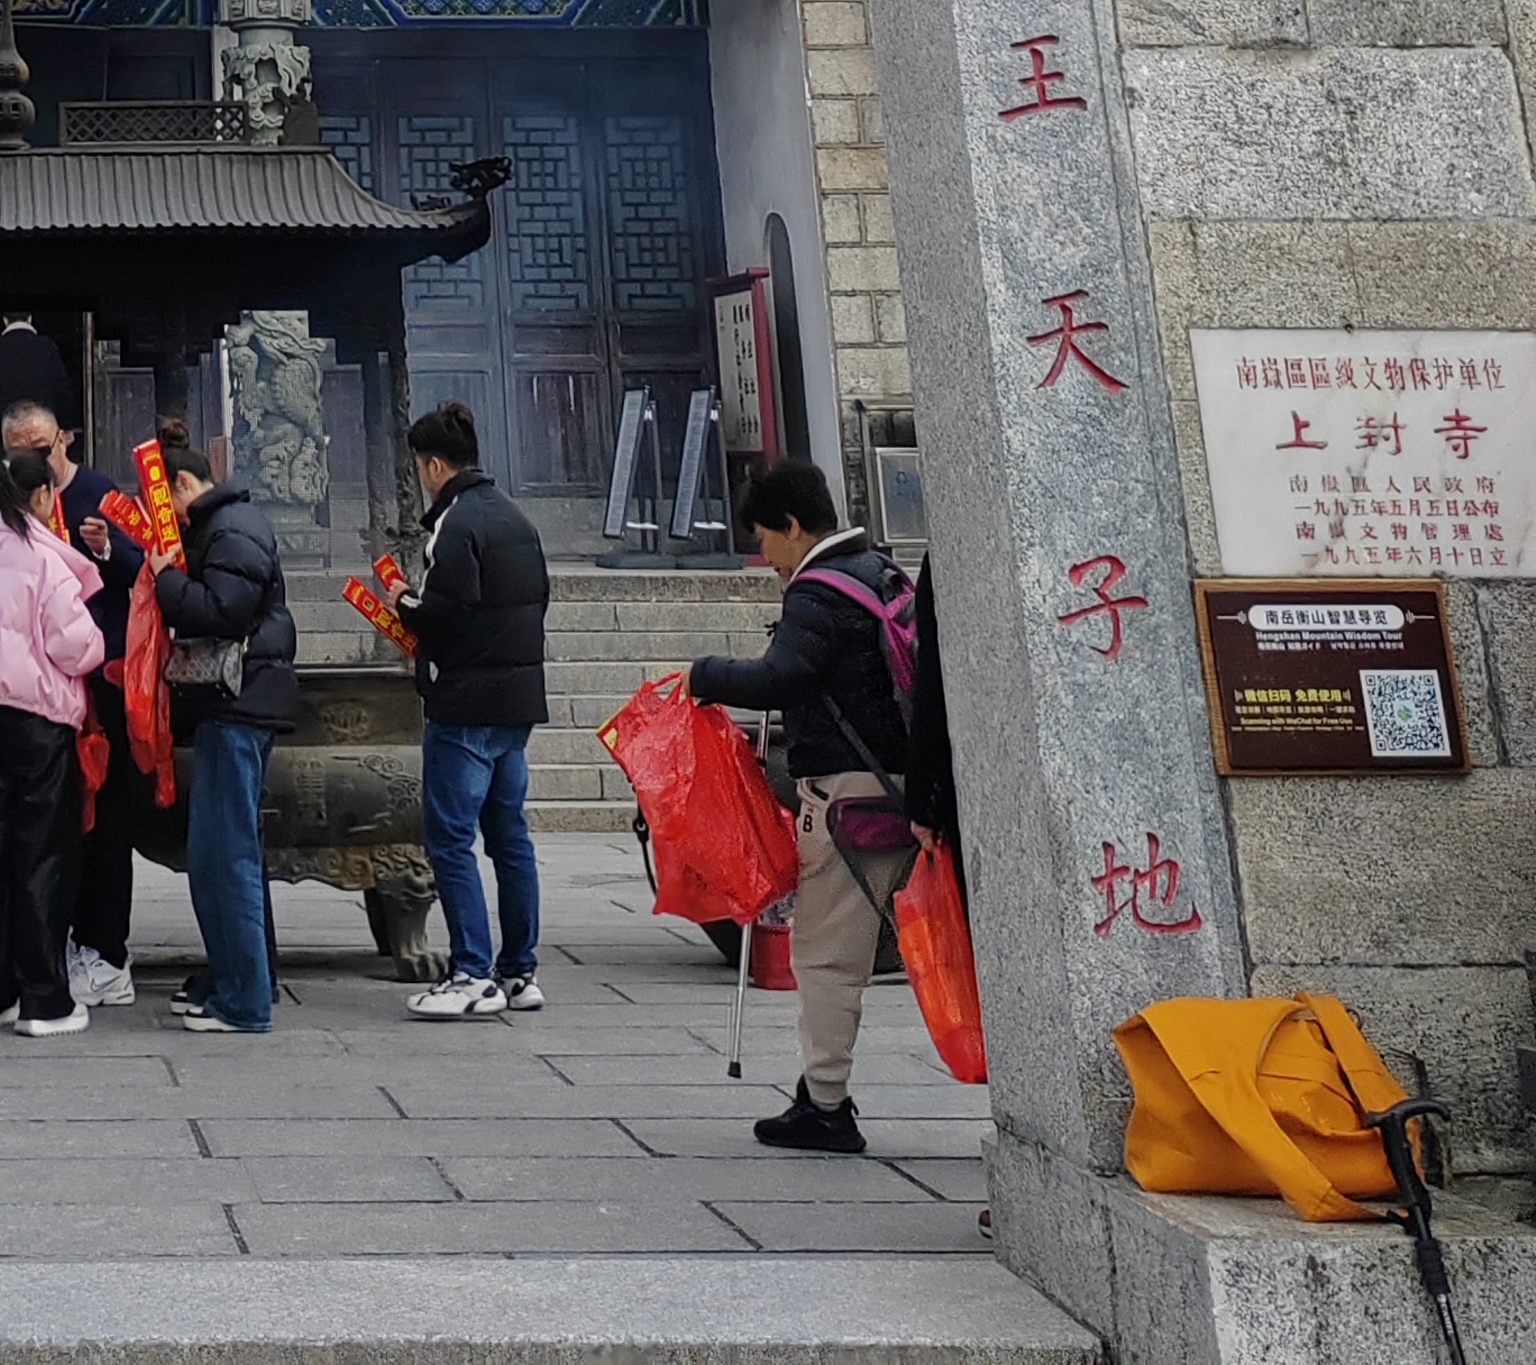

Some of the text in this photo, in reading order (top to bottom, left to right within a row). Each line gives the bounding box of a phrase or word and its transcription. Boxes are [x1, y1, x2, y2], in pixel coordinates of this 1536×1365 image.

[1276, 408, 1488, 459] 上封寺
[1294, 499, 1500, 517] 一九九五年五月五日公布
[1301, 546, 1509, 567] 一九九五年六月十日立
[1265, 609, 1388, 625] 南岳衡山智慧导览
[1255, 631, 1403, 642] Hengshan Mountain Wisdom Tour
[1244, 689, 1343, 703] 微信扫码 免费使用
